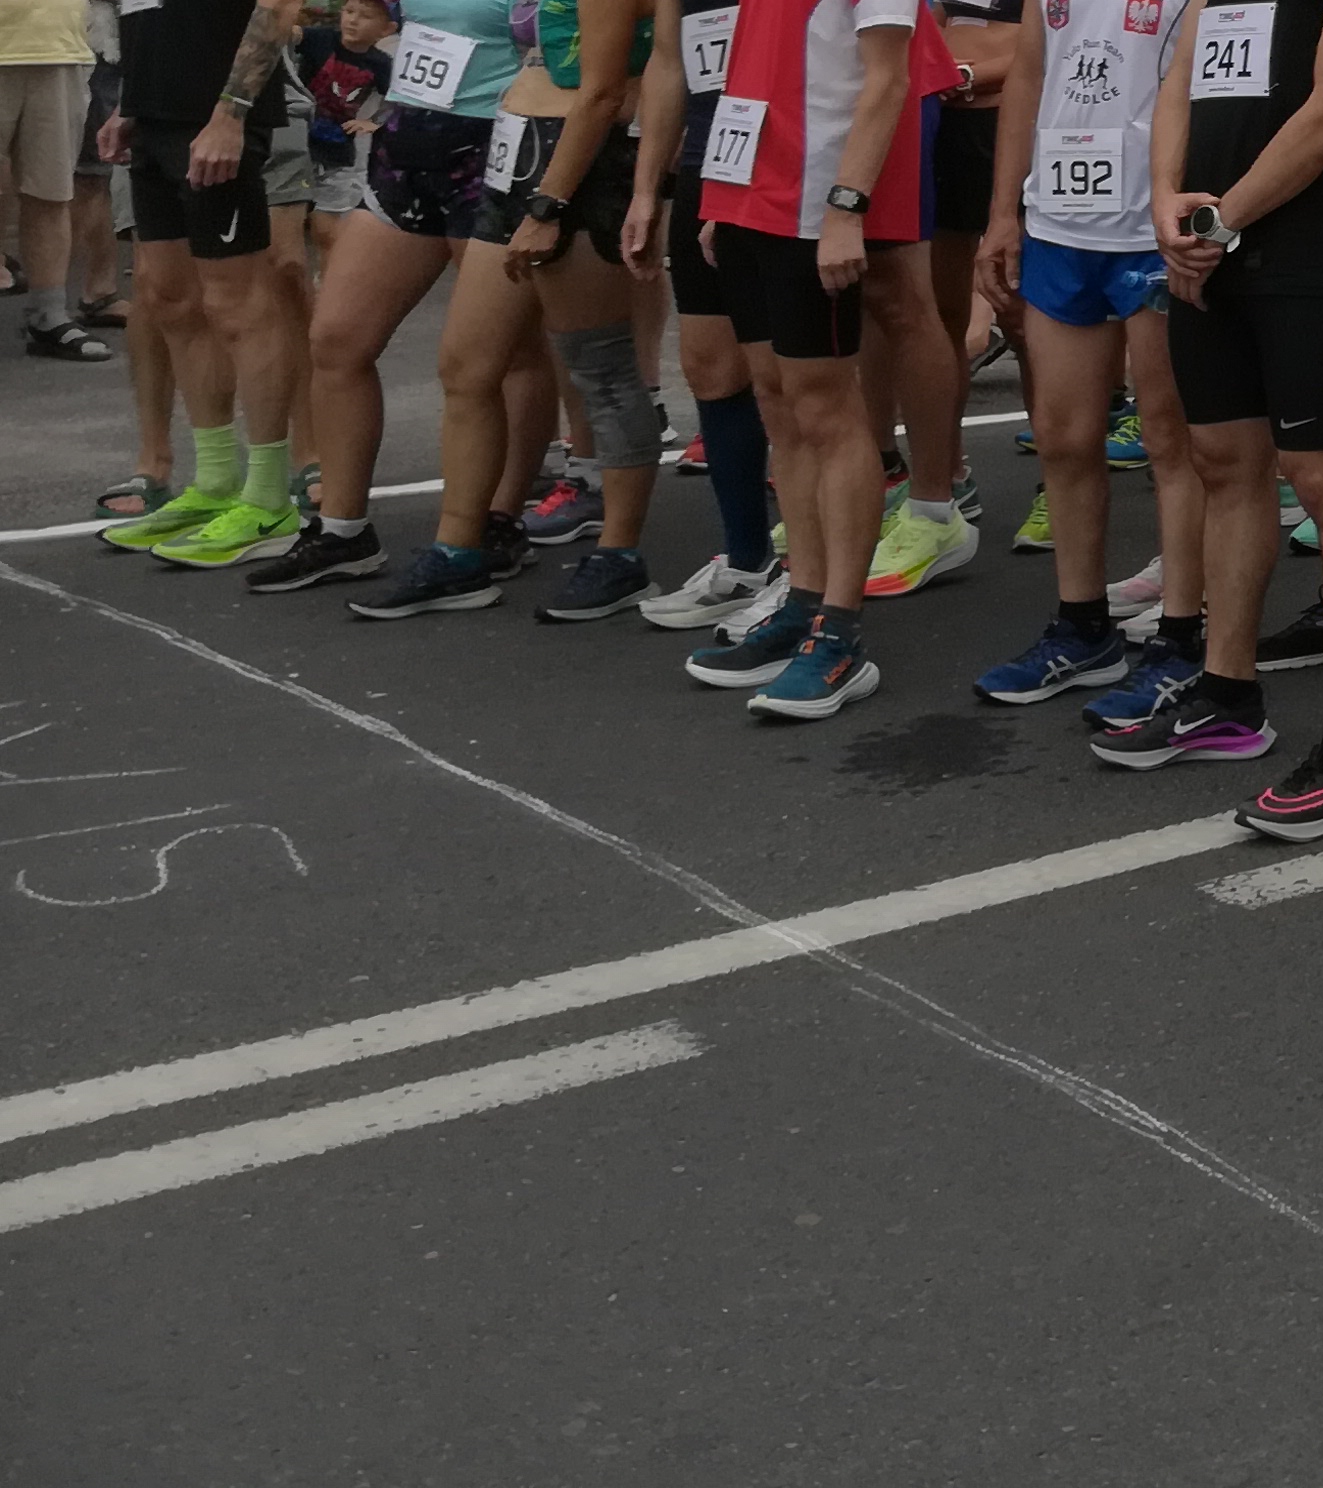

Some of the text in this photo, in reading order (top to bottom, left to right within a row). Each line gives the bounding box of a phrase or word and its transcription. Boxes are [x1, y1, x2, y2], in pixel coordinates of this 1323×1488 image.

[398, 50, 450, 90] 159
[1202, 38, 1252, 80] 241
[713, 127, 751, 166] 177
[1051, 160, 1112, 195] 192
